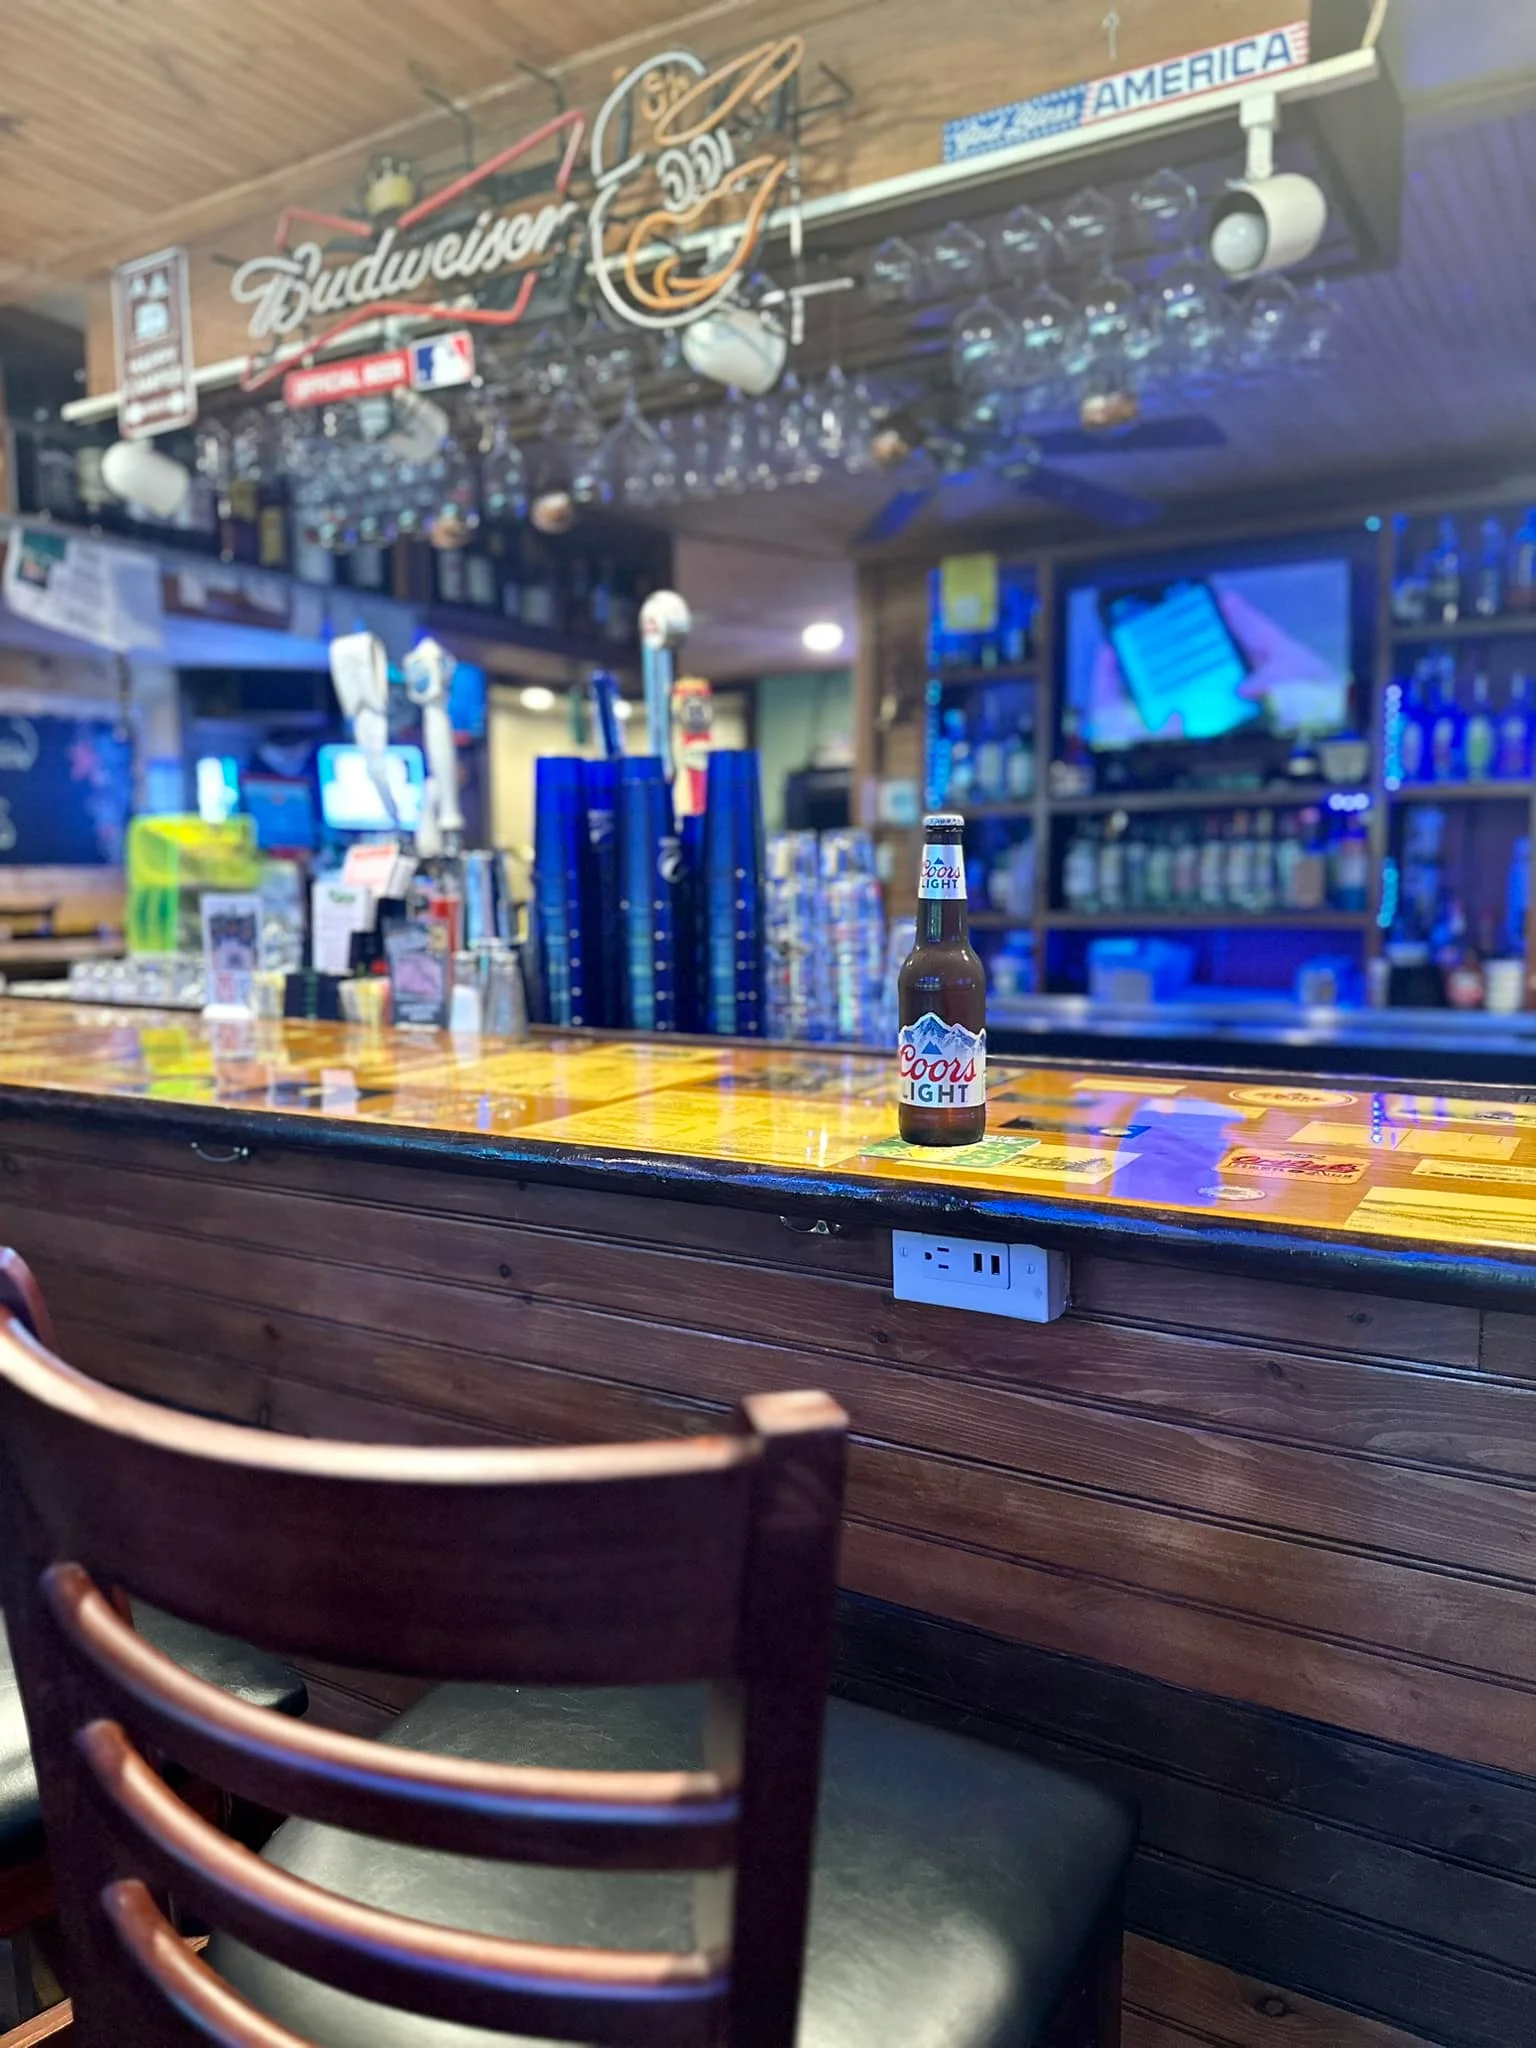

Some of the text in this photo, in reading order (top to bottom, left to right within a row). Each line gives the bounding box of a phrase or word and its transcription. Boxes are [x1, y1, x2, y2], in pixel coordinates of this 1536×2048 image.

[1092, 31, 1293, 117] AMERICA
[231, 201, 579, 338] Budweiser
[920, 860, 961, 879] Coors
[901, 1044, 976, 1083] Coors
